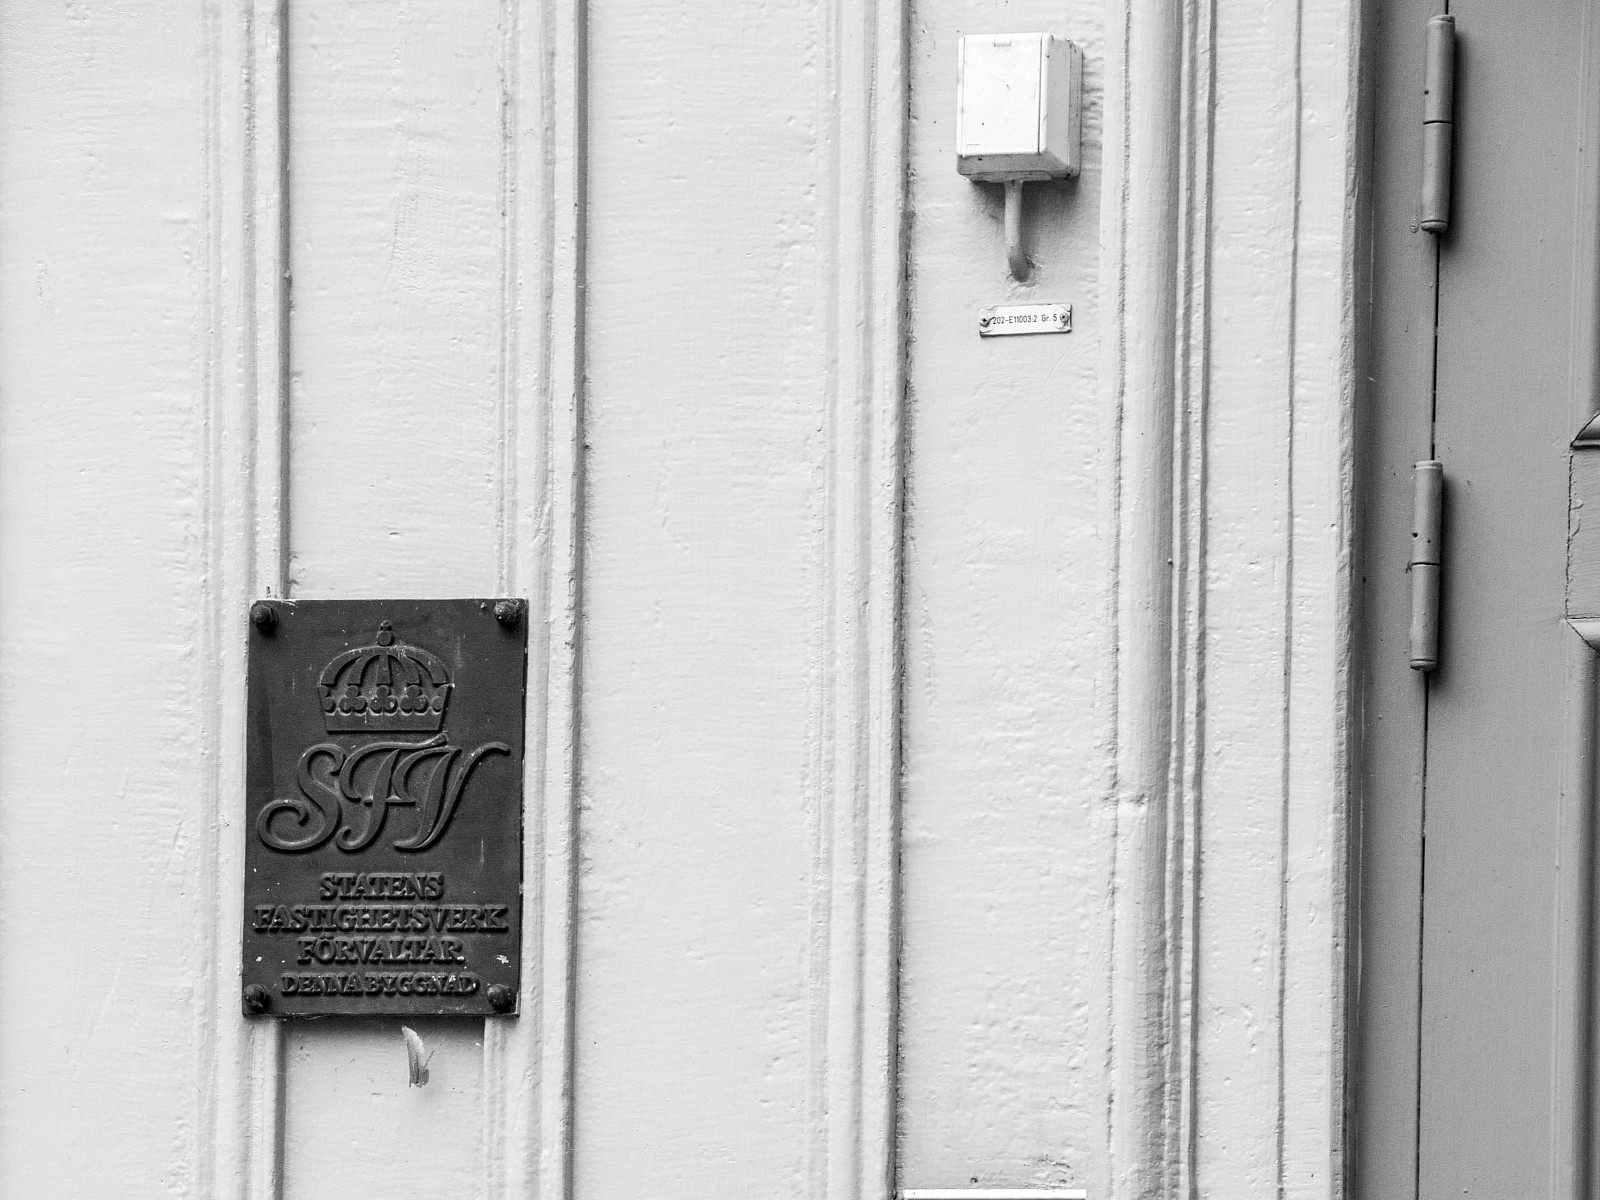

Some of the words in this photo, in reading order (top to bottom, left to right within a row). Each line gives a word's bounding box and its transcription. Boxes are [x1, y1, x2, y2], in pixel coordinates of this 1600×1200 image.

[319, 872, 444, 900] STATENS
[254, 904, 509, 933] FASTIGHETSVERK
[297, 932, 465, 965] FÖRVALTAR
[281, 972, 364, 997] DENNA
[364, 972, 481, 997] BYGGNAD
